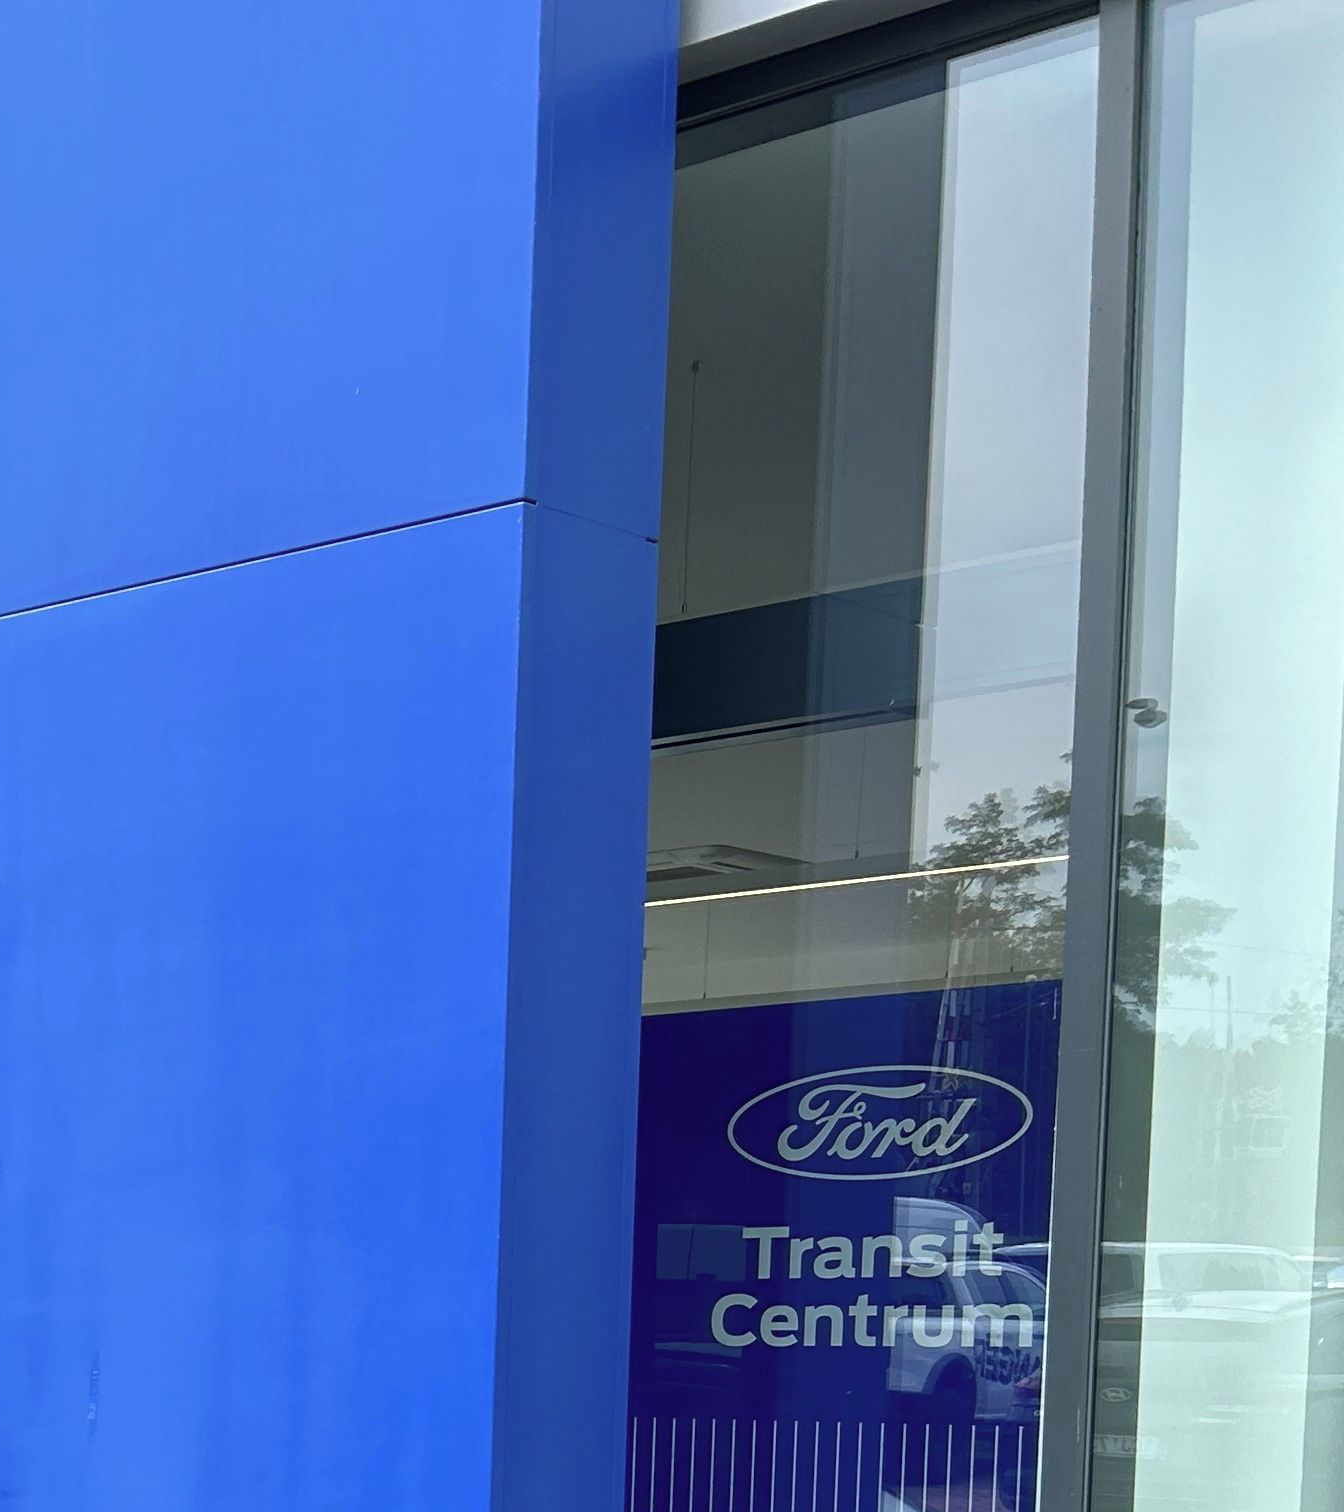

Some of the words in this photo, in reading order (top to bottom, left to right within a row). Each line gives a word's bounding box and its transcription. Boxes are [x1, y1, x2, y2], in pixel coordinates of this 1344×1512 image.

[777, 1082, 977, 1161] Ford
[742, 1220, 1004, 1280] Transit
[712, 1294, 1033, 1348] Centrum
